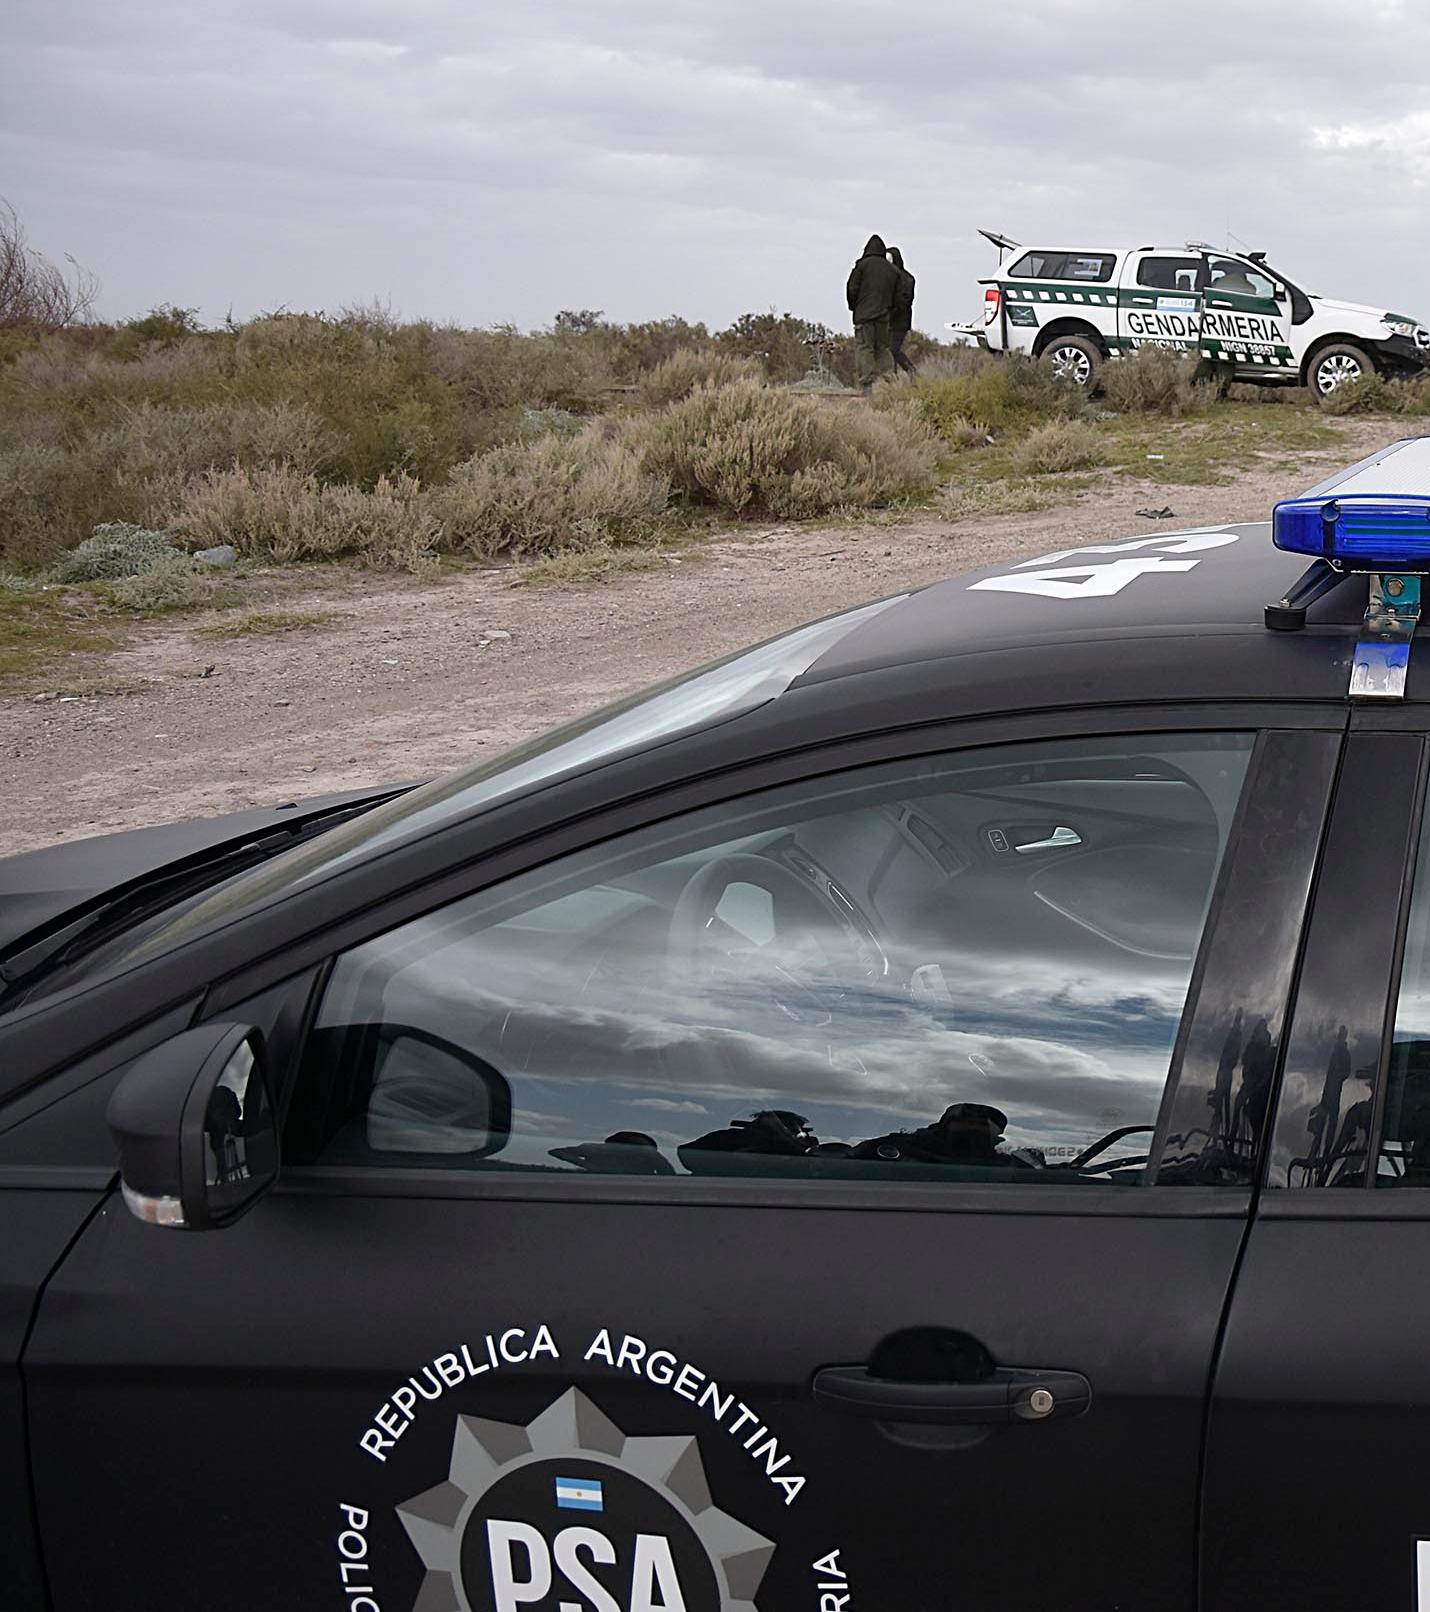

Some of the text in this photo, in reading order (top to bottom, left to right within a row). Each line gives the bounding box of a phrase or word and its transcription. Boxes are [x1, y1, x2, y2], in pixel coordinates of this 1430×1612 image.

[1127, 312, 1285, 343] GENDARMERIA
[359, 1325, 807, 1506] REPUBLICA ARGENTINA
[486, 1519, 688, 1612] PSA
